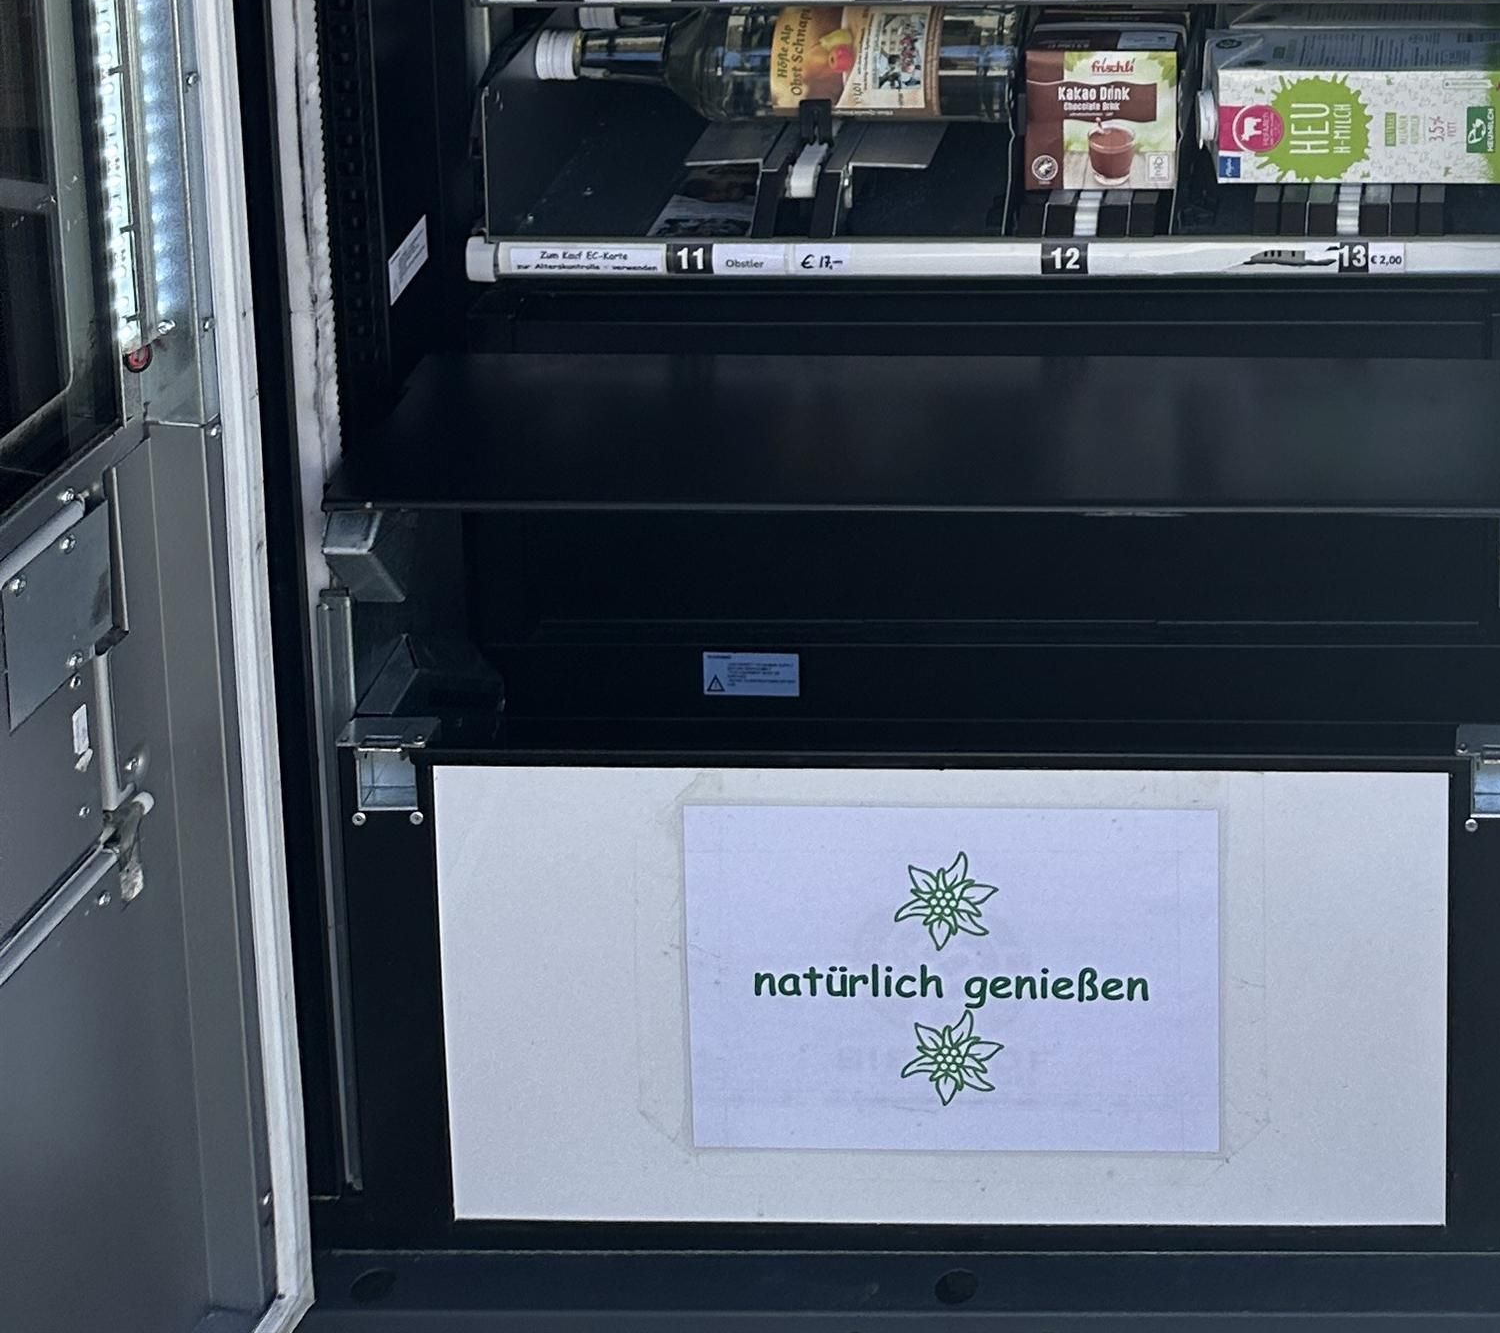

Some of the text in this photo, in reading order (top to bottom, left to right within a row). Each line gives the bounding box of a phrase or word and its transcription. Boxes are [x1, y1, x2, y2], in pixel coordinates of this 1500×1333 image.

[1091, 58, 1136, 73] frischli
[1058, 85, 1130, 101] Kakao Drink
[1289, 103, 1330, 154] HEU
[1333, 104, 1351, 153] H-MILCH
[677, 247, 705, 269] 11
[726, 259, 763, 269] Obstler
[801, 254, 815, 268] €
[1051, 247, 1080, 270] 12
[1339, 244, 1367, 267] 13
[1371, 255, 1402, 266] € 2,00
[753, 963, 1149, 1008] natürlich genießen
